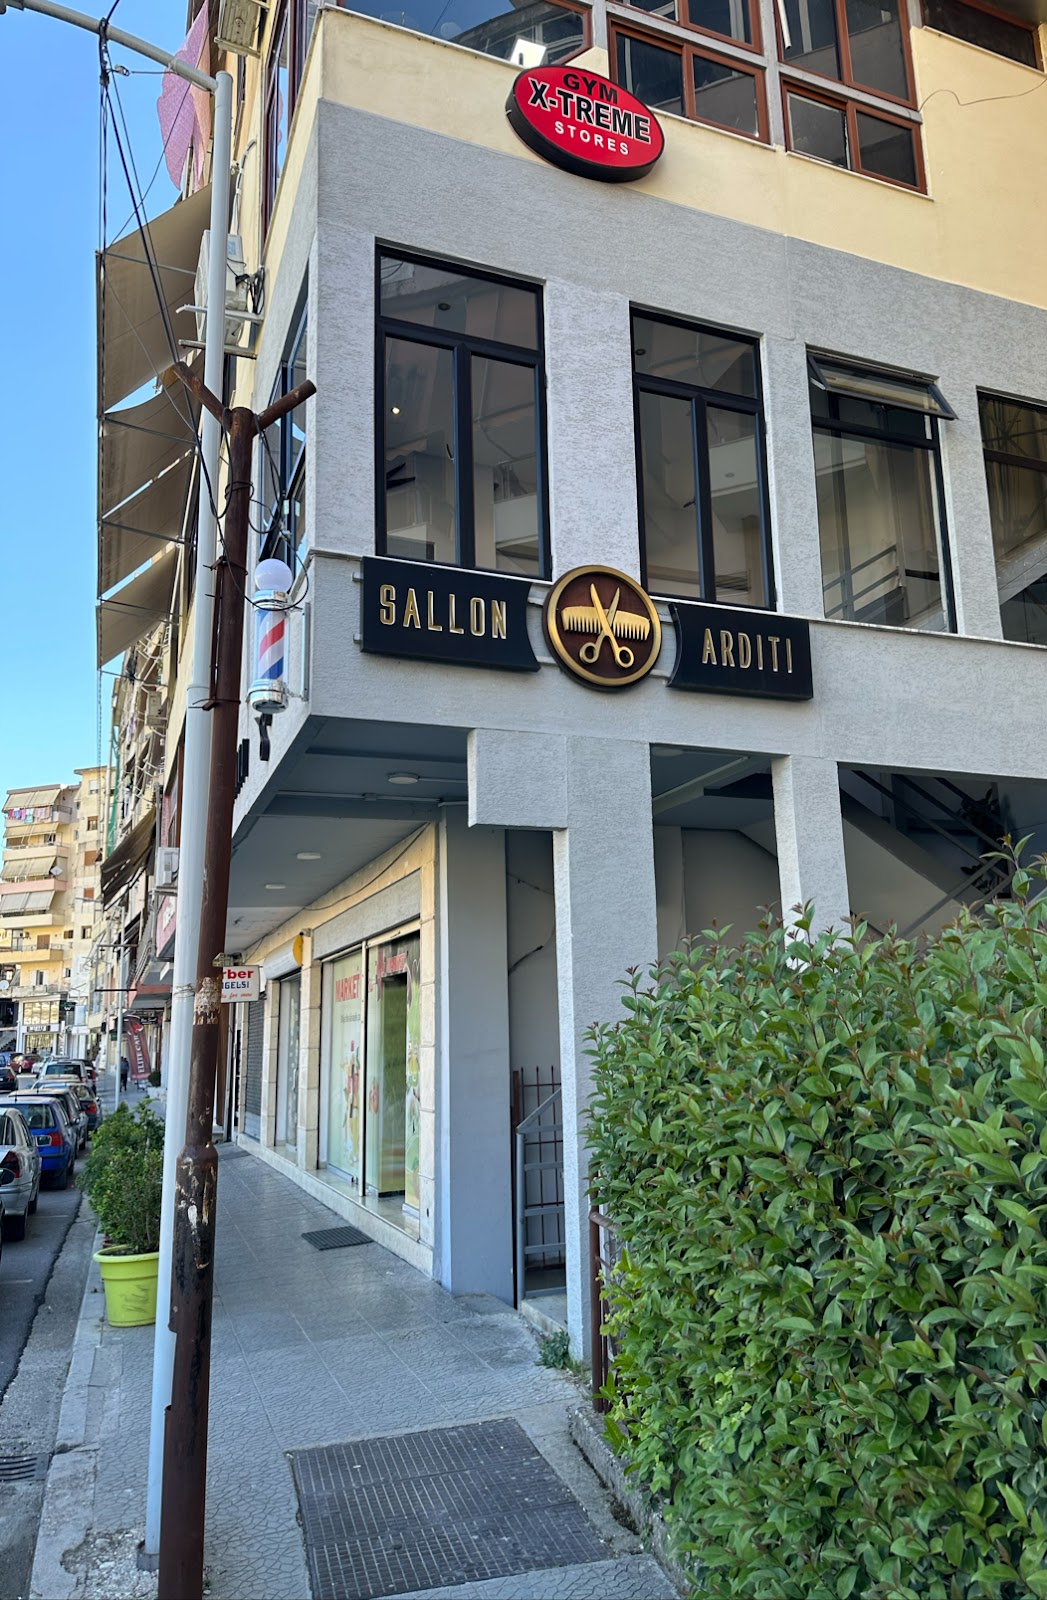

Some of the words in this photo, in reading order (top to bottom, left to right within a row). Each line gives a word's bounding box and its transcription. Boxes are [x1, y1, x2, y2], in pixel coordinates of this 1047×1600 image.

[563, 73, 618, 104] GYM
[528, 77, 651, 144] X-TREME
[554, 121, 629, 155] STORES
[380, 584, 507, 639] SALLON
[702, 628, 793, 673] ARDITI
[336, 974, 360, 1002] MARKET
